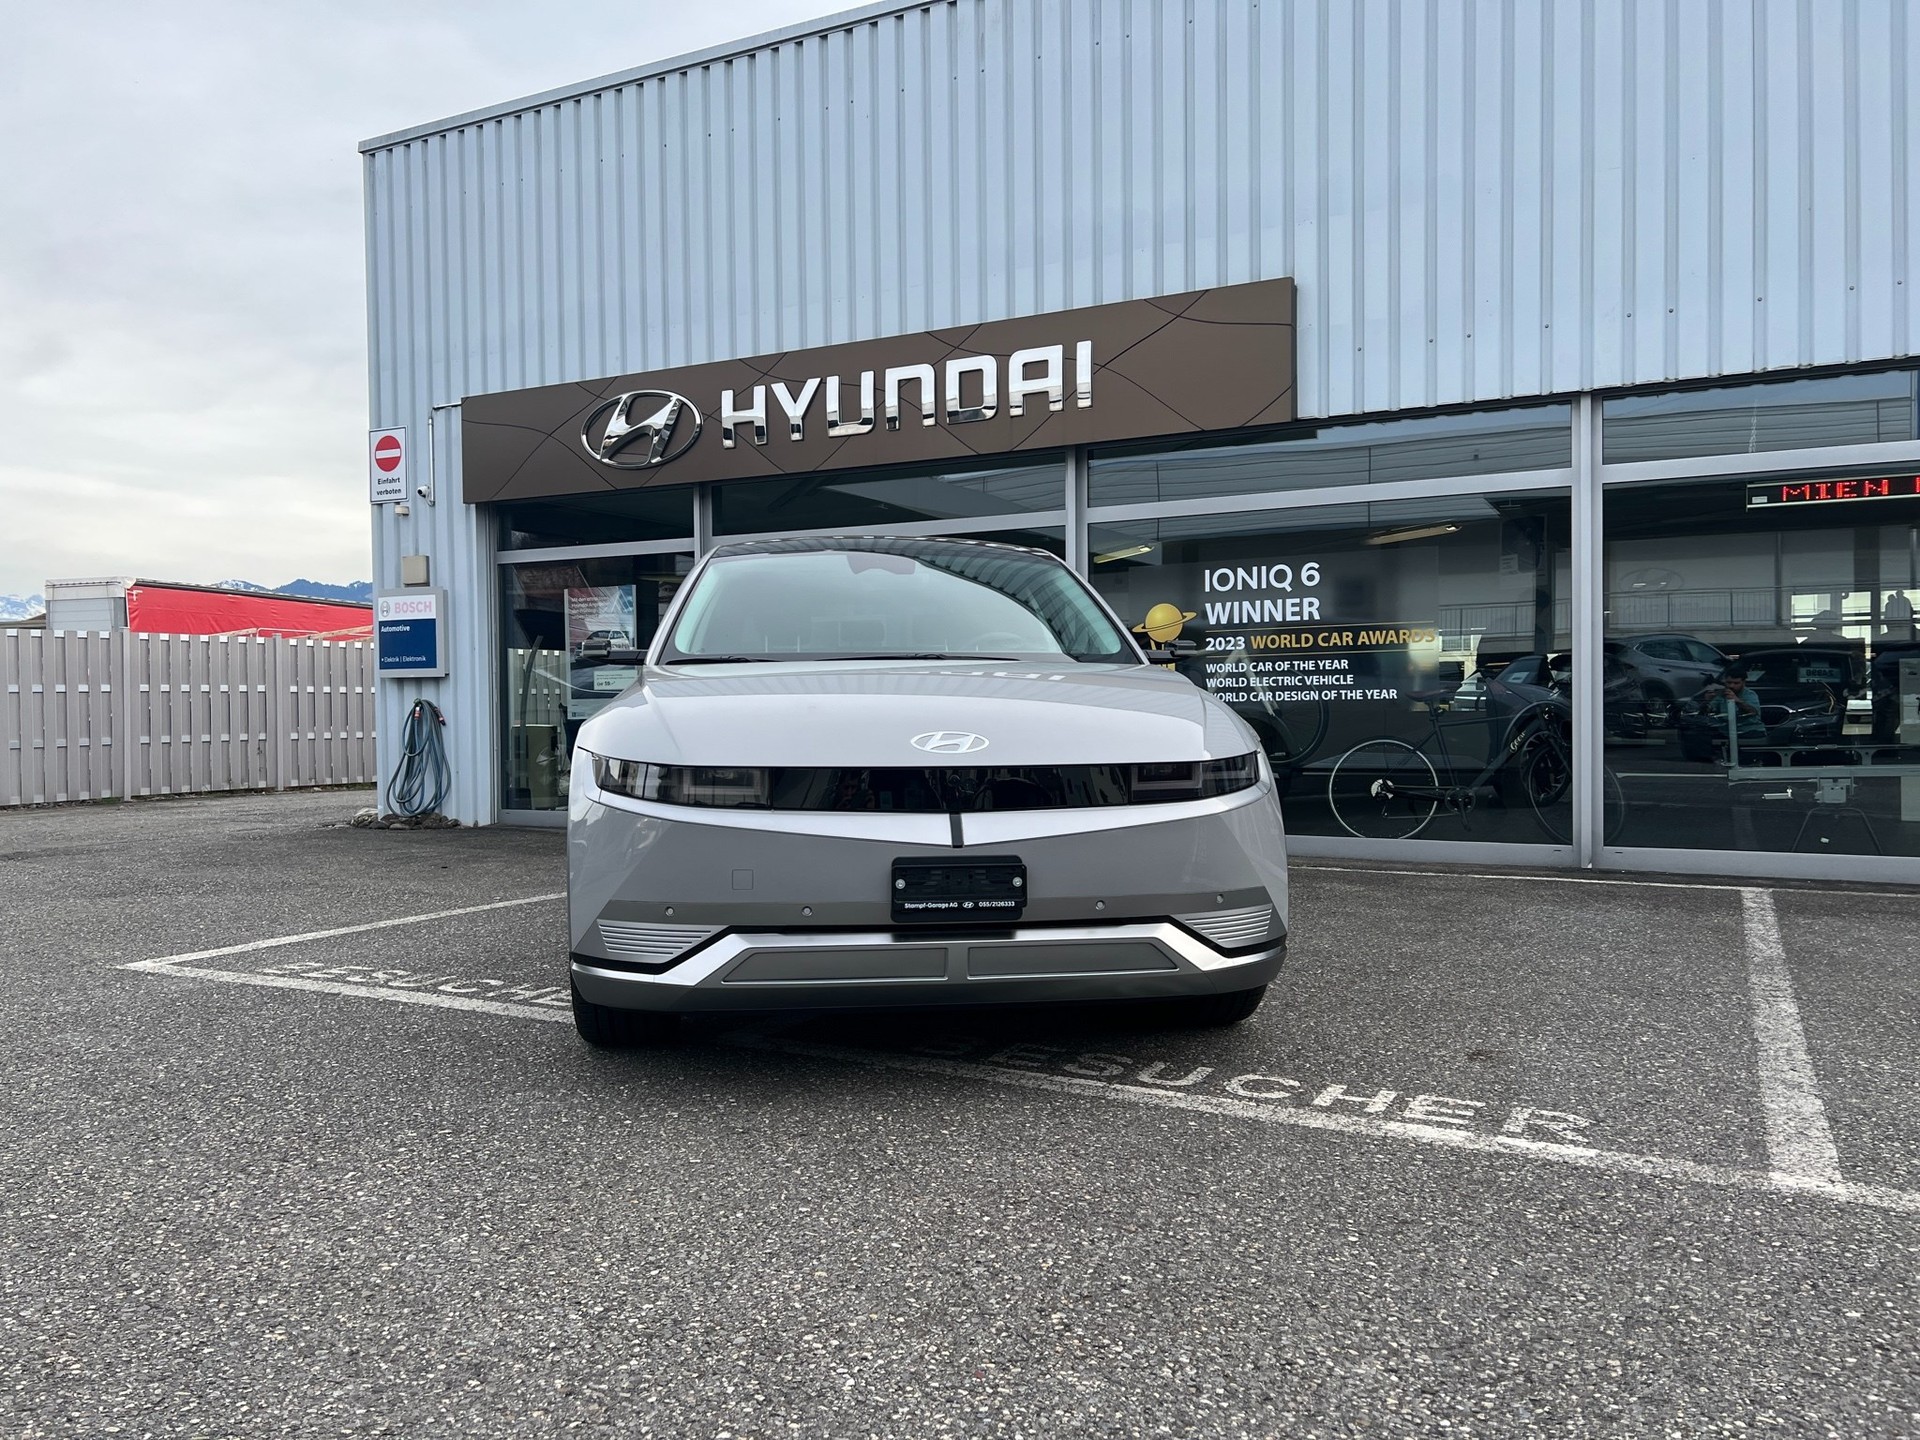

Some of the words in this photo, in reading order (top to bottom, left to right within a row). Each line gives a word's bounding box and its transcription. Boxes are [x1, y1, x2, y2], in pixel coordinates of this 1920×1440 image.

[721, 340, 1093, 449] HYUNDAI
[377, 477, 401, 485] Einfahrt
[376, 488, 402, 496] verboten
[1782, 479, 1889, 502] MIEN
[1204, 564, 1292, 592] IONIQ
[1300, 562, 1320, 587] 6
[394, 601, 432, 614] BOSCH
[1205, 597, 1320, 625] WINNER
[381, 624, 410, 632] Automotive
[1205, 636, 1246, 651] 2023
[1251, 633, 1314, 650] WORLD
[1317, 631, 1353, 648] CAR
[1357, 628, 1436, 646] AWARDS
[1206, 662, 1247, 674] WORLD
[1250, 661, 1272, 673] CAR
[1275, 660, 1291, 672] OF
[1293, 660, 1316, 671] THE
[1317, 659, 1349, 671] YEAR
[1206, 676, 1247, 688] WORLD
[1250, 675, 1303, 687] ELECTRIC
[1304, 674, 1354, 686] VEHICLE
[1214, 691, 1247, 703] ORLD
[1250, 691, 1274, 702] CAR
[1276, 690, 1319, 701] DESIGN
[1322, 690, 1338, 700] OF
[1340, 689, 1363, 700] THE
[1365, 689, 1397, 700] YEAR
